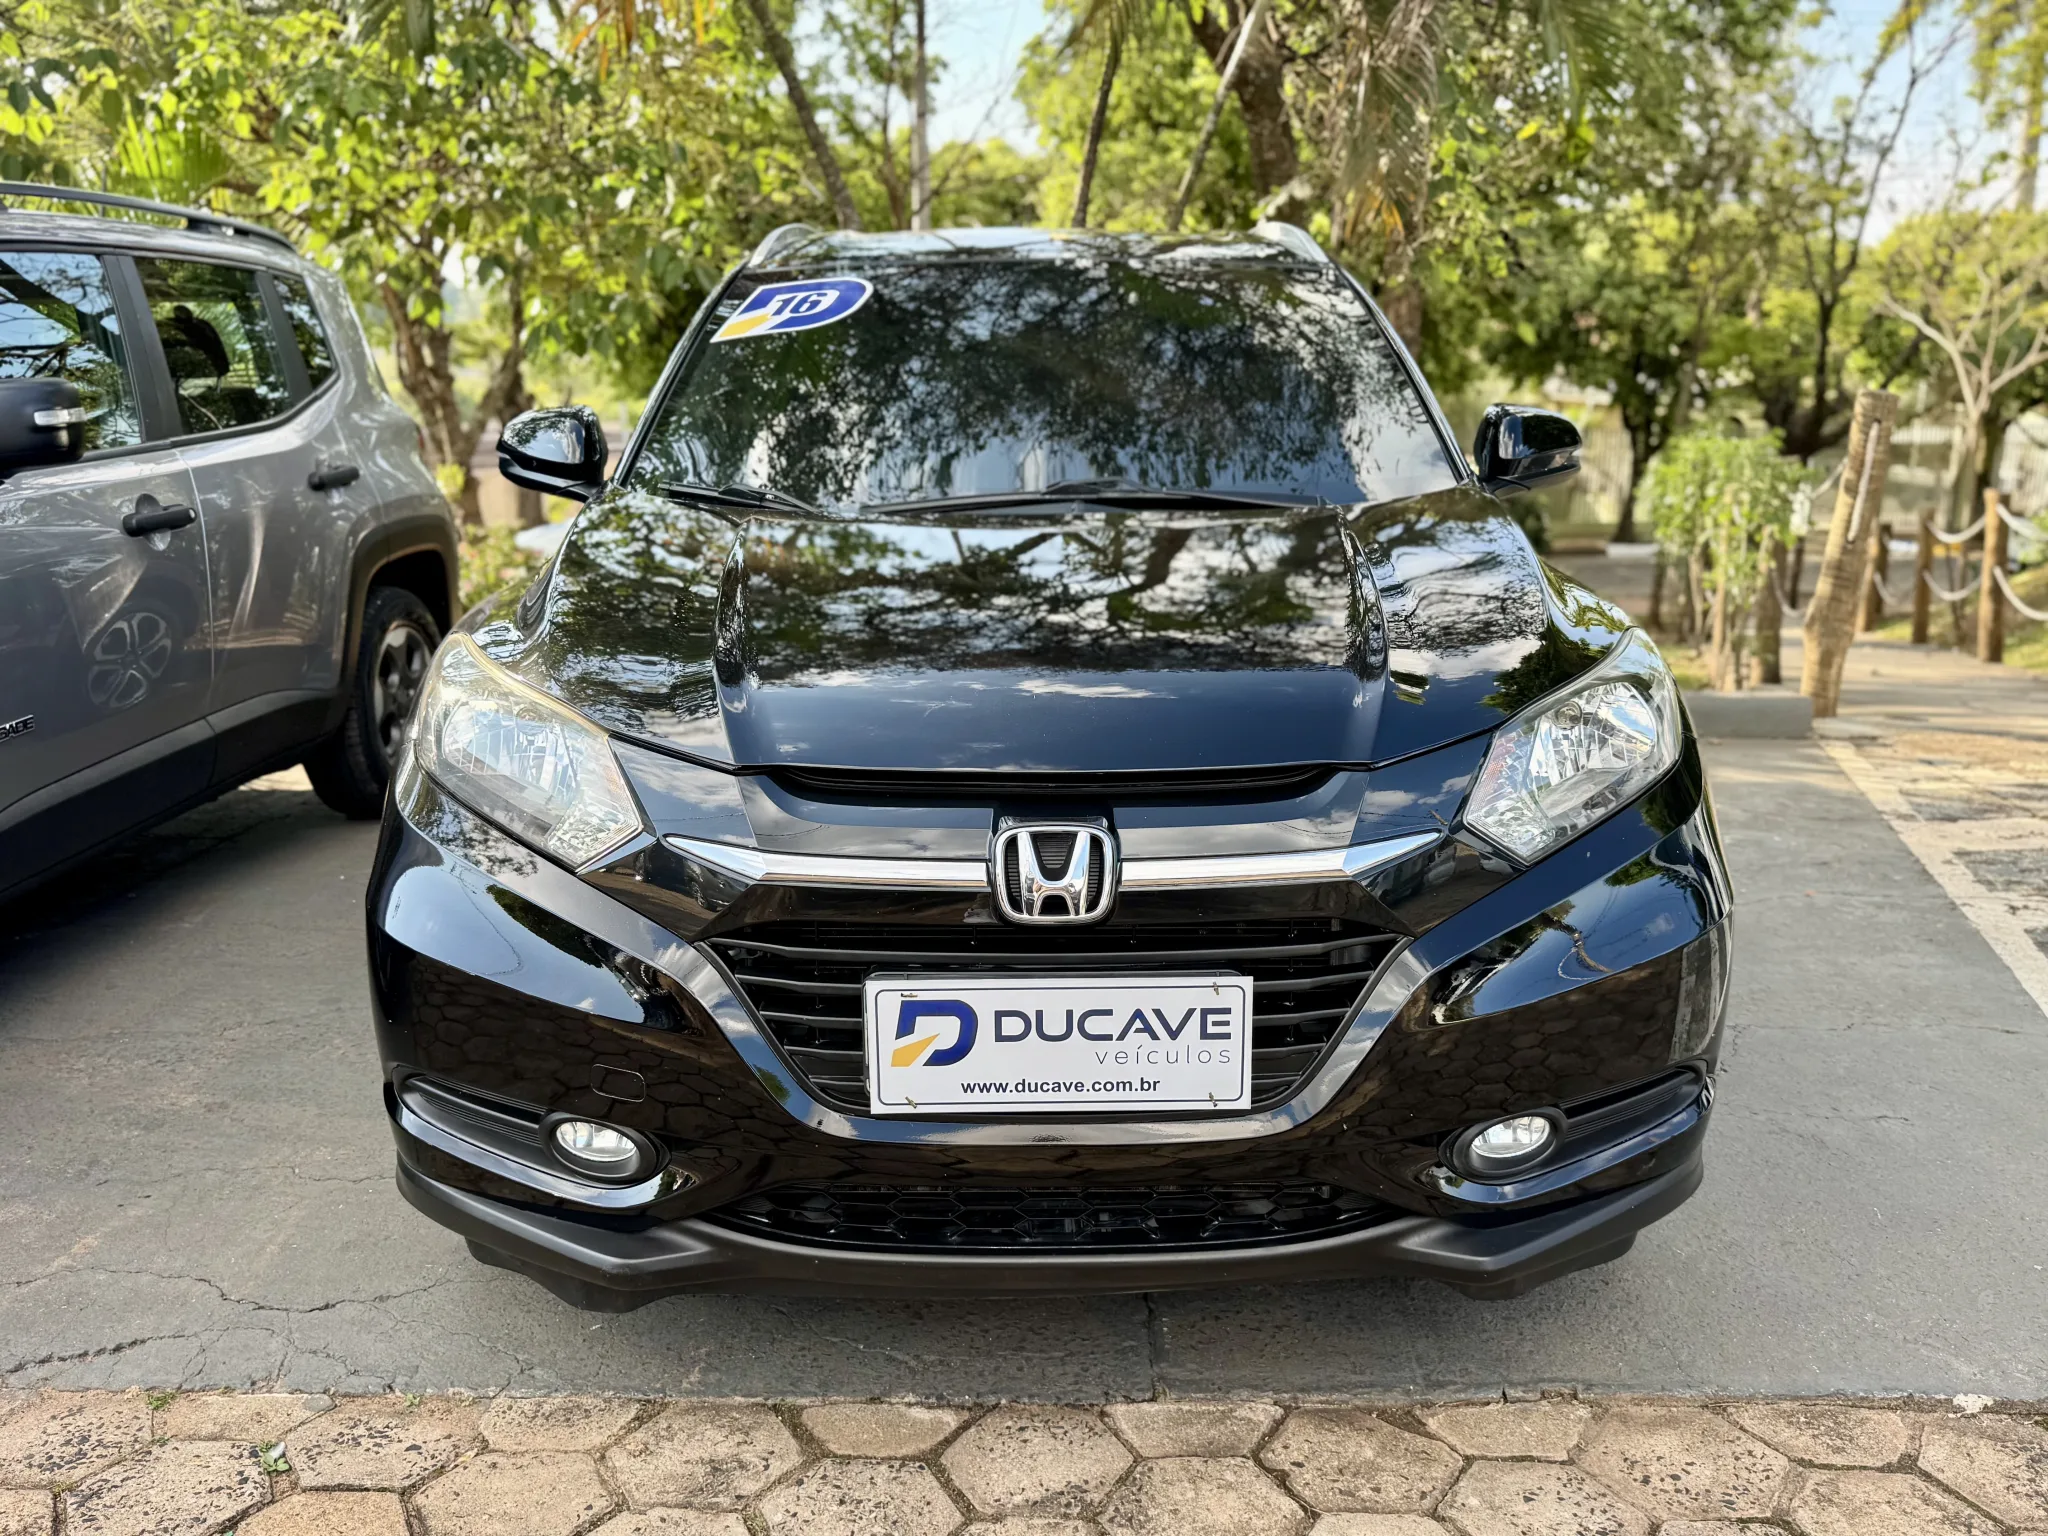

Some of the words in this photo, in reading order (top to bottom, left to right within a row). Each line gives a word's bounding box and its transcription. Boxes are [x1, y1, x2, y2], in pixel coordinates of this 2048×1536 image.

[770, 291, 829, 317] 16
[994, 1007, 1232, 1043] DUCAVE
[1094, 1044, 1231, 1065] veículos
[960, 1076, 1161, 1094] www.ducave.com.br
